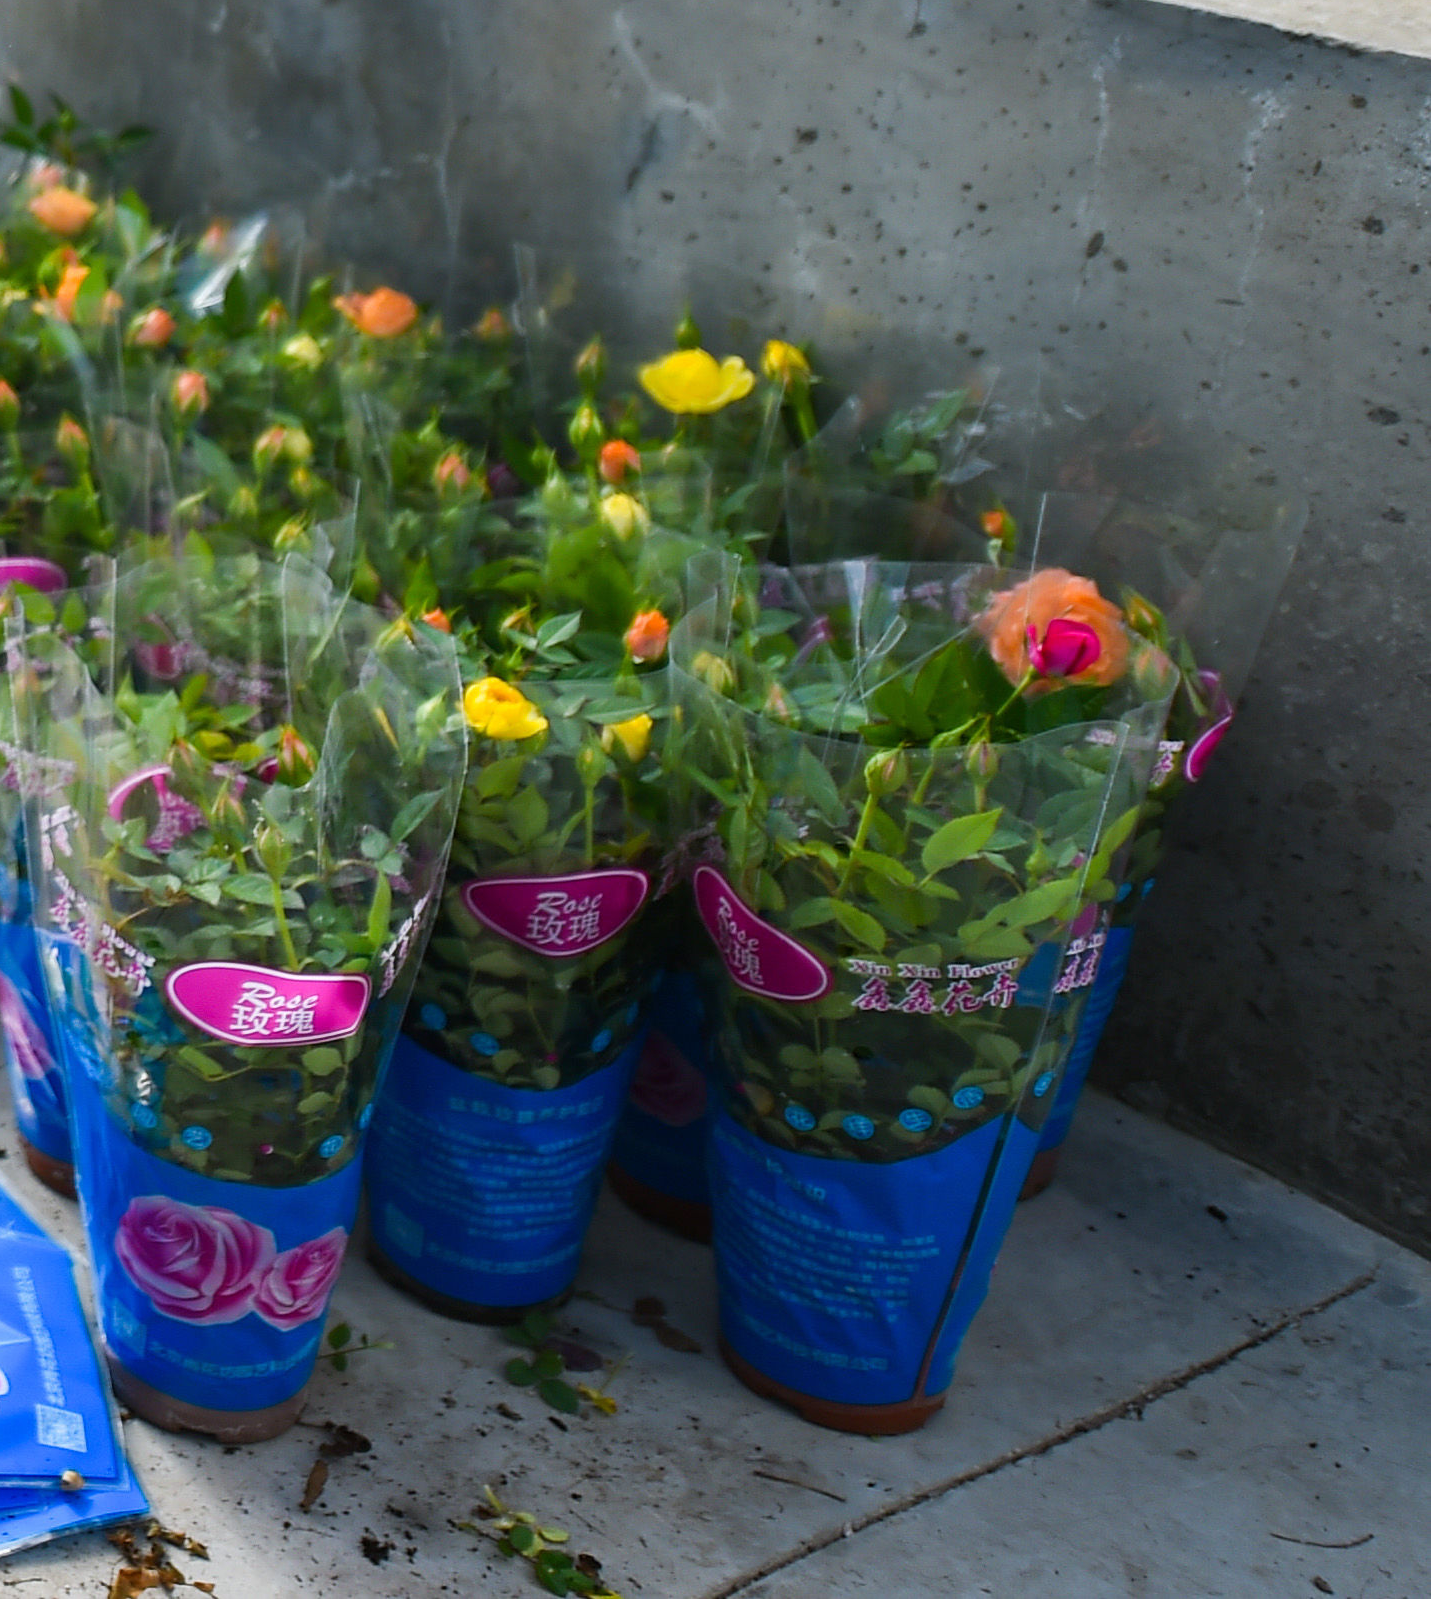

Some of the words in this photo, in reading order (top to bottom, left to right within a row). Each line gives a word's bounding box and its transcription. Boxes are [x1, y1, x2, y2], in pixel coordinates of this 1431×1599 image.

[533, 891, 604, 916] Rose
[526, 911, 602, 946] 玫瑰
[846, 958, 893, 977] Xin
[897, 963, 942, 979] Xin
[946, 956, 1020, 979] Flower
[237, 981, 320, 1011] Rose
[851, 972, 1020, 1017] 鑫鑫花卉
[229, 1004, 316, 1036] 玫瑰
